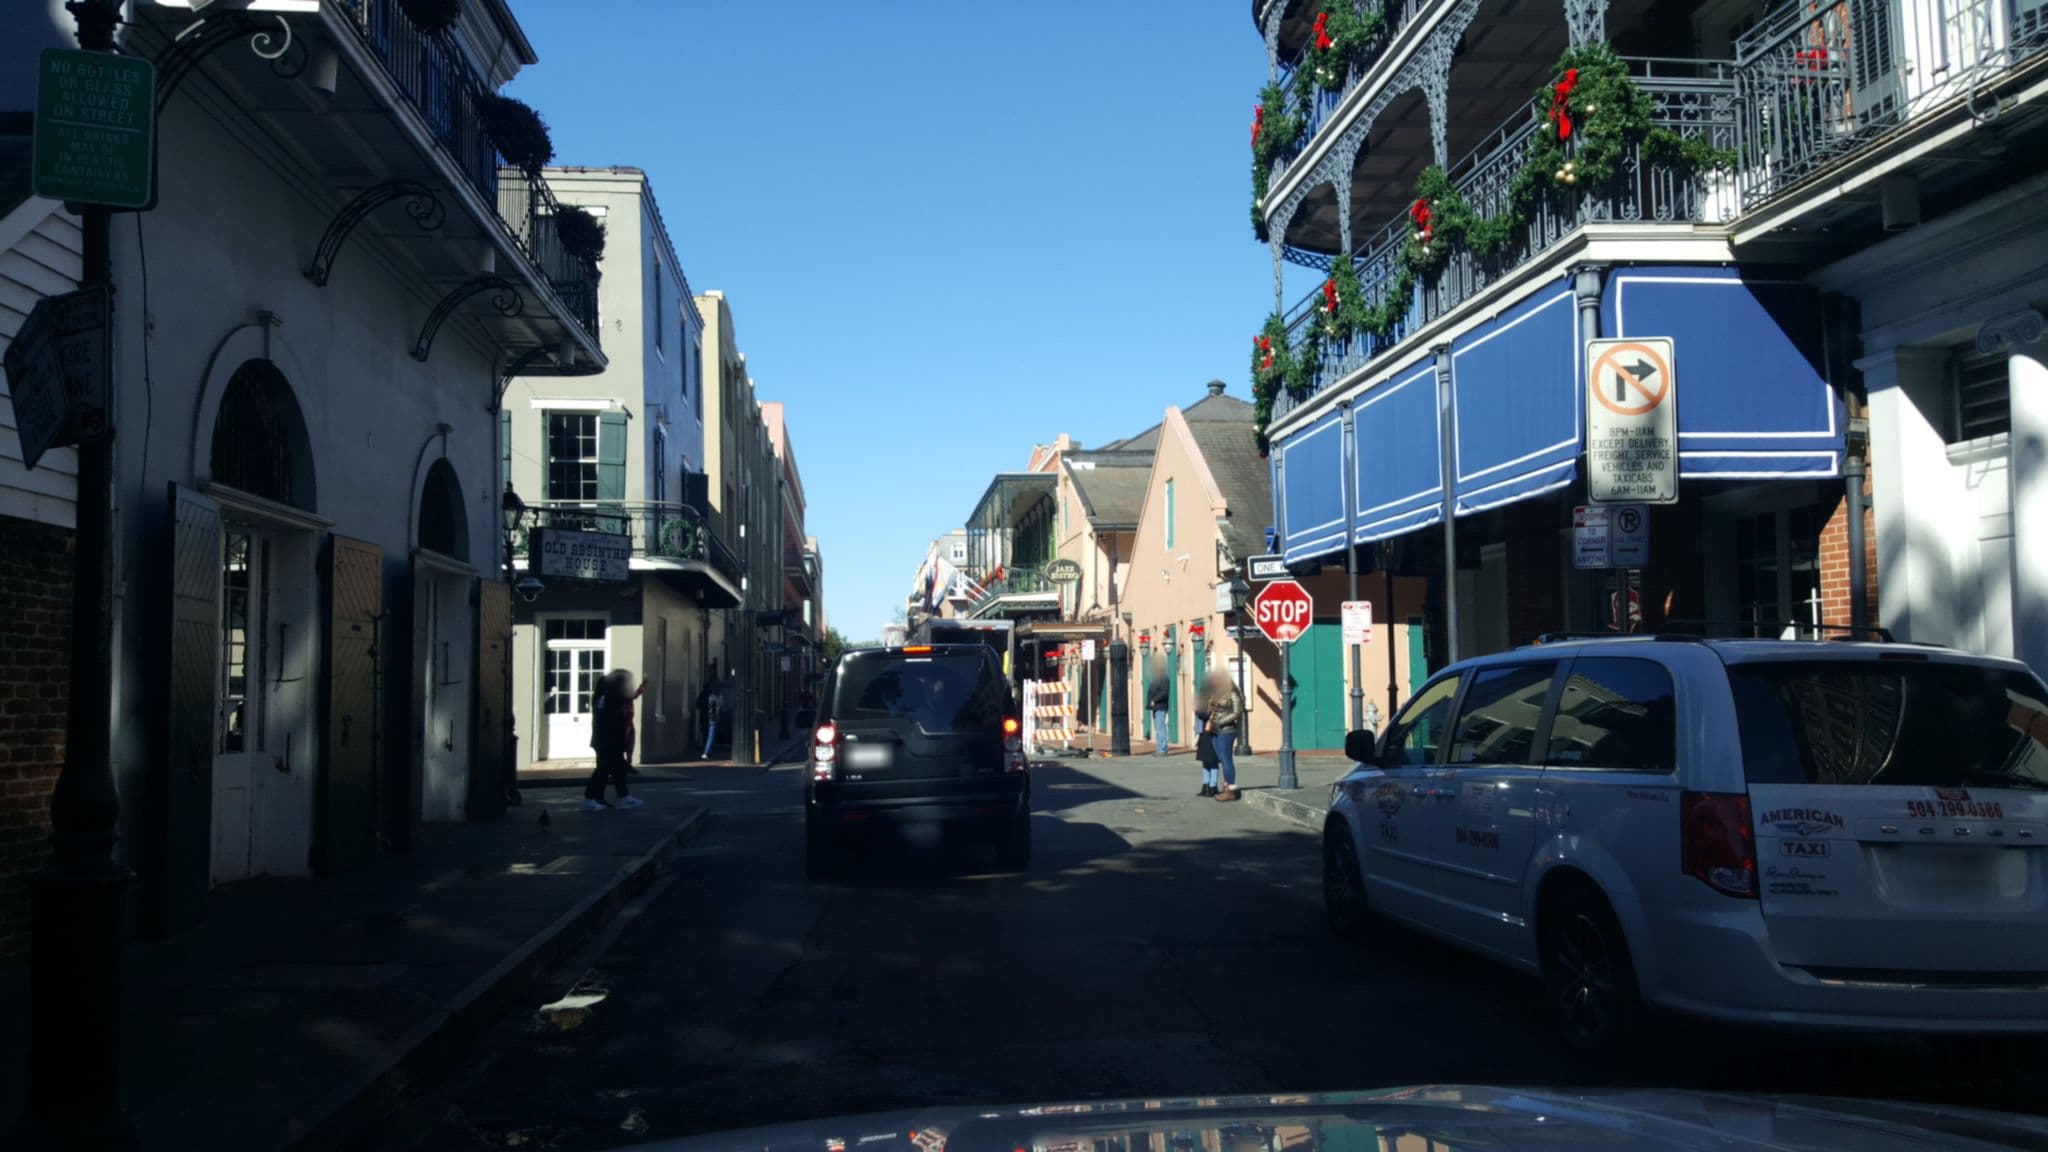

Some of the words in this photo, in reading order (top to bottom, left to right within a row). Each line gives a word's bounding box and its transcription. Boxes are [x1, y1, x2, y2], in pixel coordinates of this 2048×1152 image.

[51, 60, 71, 74] NO
[61, 91, 130, 111] ALLOWED
[53, 104, 75, 118] ON
[80, 108, 136, 125] STREET
[1592, 438, 1625, 450] EXCEPT
[1635, 450, 1671, 460] SERVICE
[1601, 462, 1643, 472] VEHICLES
[1647, 461, 1664, 471] AND
[1613, 473, 1654, 484] TAXICABS
[545, 541, 567, 556] OLD
[570, 544, 628, 561] ABSINTHE
[565, 556, 607, 571] HOUSE
[1256, 564, 1278, 574] ONE
[1259, 599, 1309, 624] STOP
[1760, 808, 1845, 830] AMERICAN
[1784, 842, 1826, 855] TAXI
